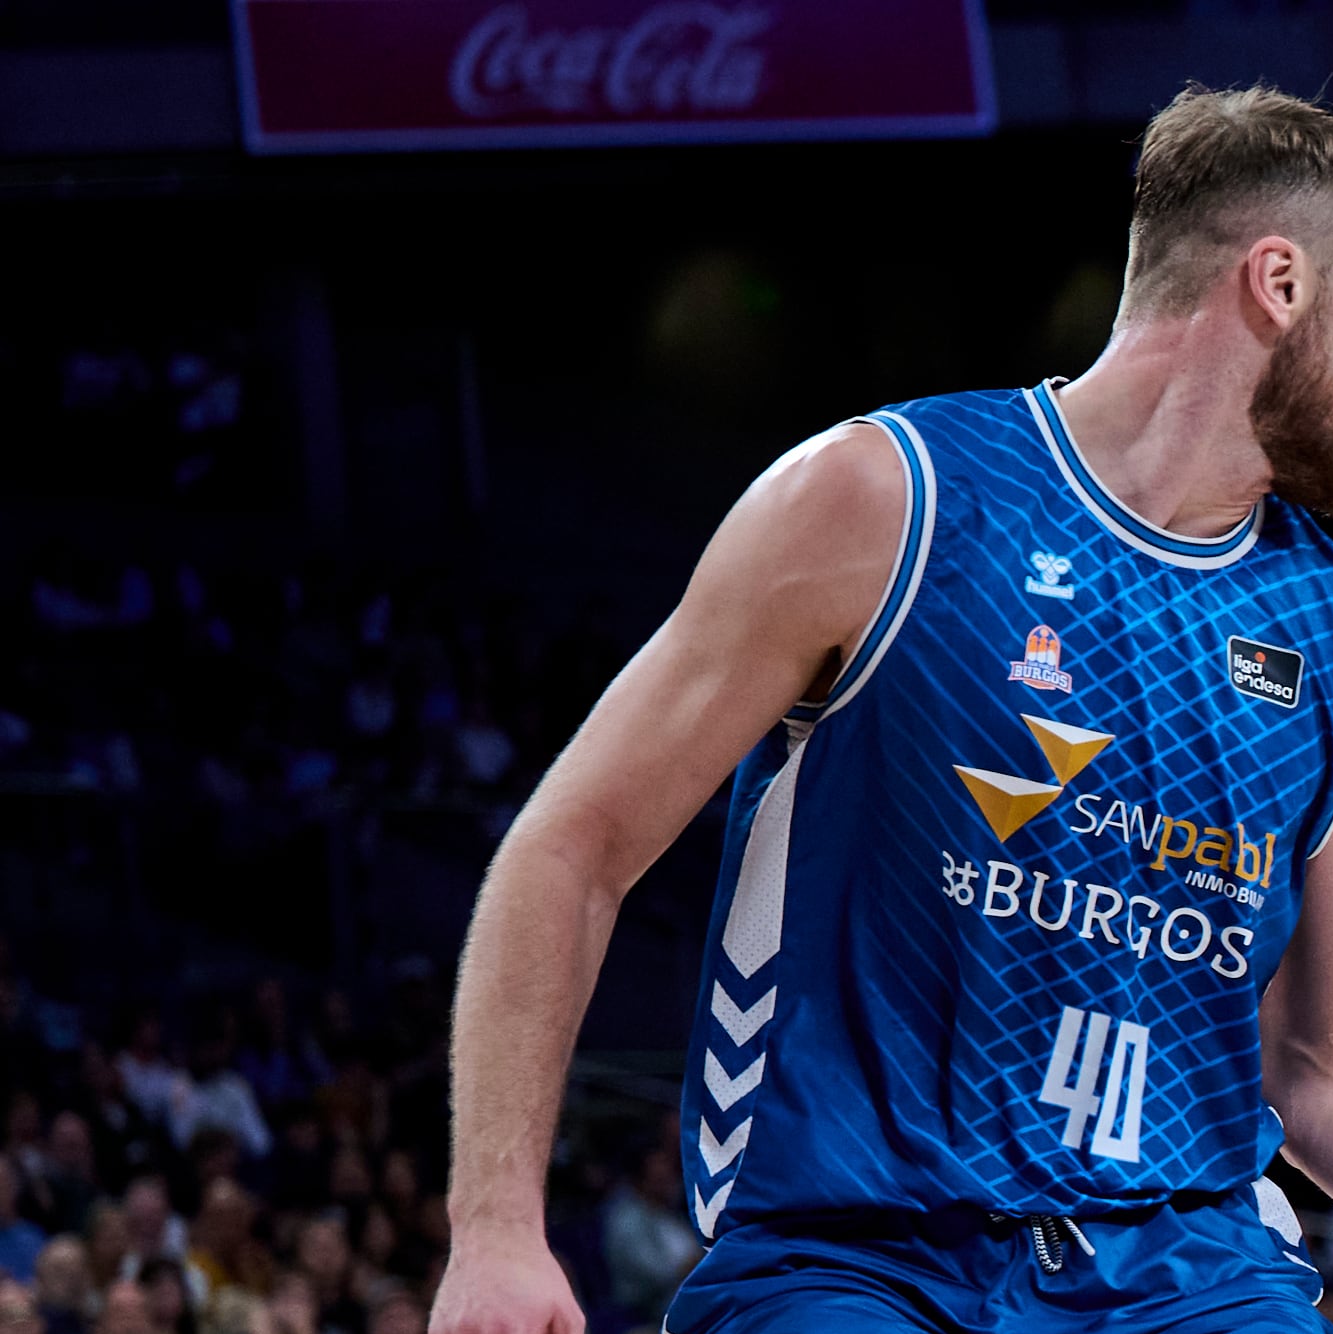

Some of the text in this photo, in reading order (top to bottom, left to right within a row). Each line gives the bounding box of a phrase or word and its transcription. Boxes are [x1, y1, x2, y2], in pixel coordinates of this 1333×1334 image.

[1014, 664, 1068, 689] BURGOS
[1233, 653, 1263, 675] liga
[1233, 671, 1294, 700] endesa
[1070, 793, 1278, 889] SANpabl
[982, 859, 1254, 979] BURGOS
[1039, 1004, 1150, 1164] 40
